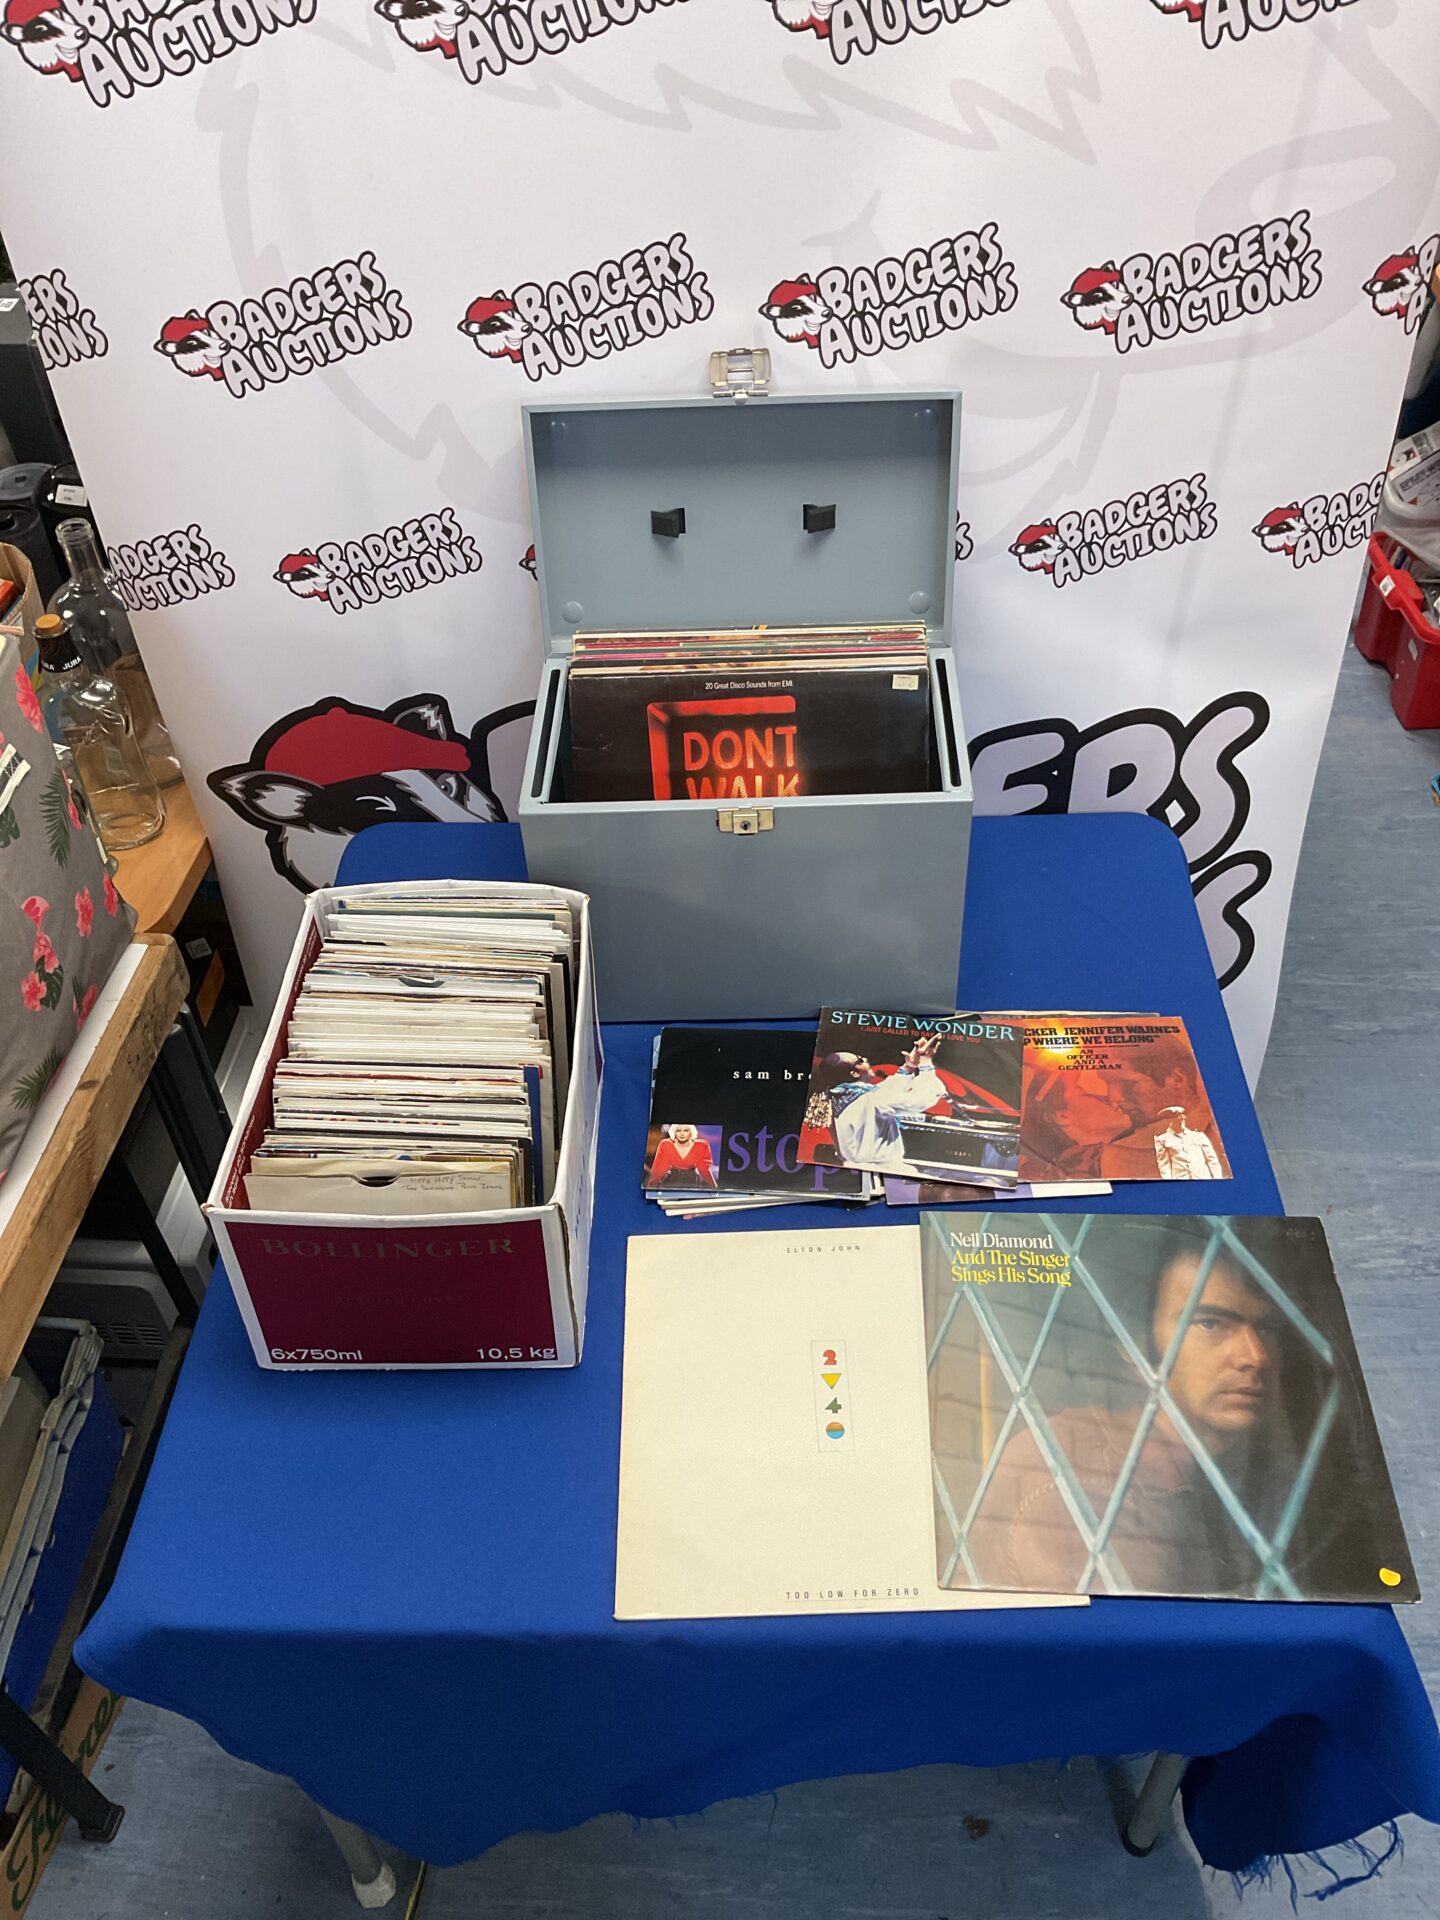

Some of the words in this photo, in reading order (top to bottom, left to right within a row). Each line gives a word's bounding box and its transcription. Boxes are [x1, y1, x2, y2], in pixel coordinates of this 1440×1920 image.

[1120, 208, 1312, 300] BADGERS
[512, 232, 693, 334] BADGERS
[816, 221, 1002, 320] BADGERS
[205, 250, 386, 352] BADGERS
[818, 261, 1018, 369] AUCTIONS
[1114, 249, 1322, 354] AUCTIONS
[521, 271, 714, 382] AUCTIONS
[222, 289, 412, 398] AUCTIONS
[1056, 472, 1207, 550] BADGERS
[316, 507, 462, 578] BADGERS
[1052, 502, 1217, 588] AUCTIONS
[116, 552, 235, 612] UCTIONS
[326, 535, 482, 614] AUCTIONS
[705, 682, 713, 690] 20
[714, 681, 730, 690] Great
[730, 681, 745, 689] Disco
[746, 680, 767, 689] Sounds
[767, 680, 781, 688] from
[684, 726, 798, 771] DONT
[686, 772, 800, 800] WALK
[831, 1011, 907, 1029] STEVIE
[913, 1018, 1015, 1041] WONDER
[883, 1027, 909, 1036] CALLED
[966, 1036, 980, 1044] YOU
[1065, 1026, 1124, 1036] JENNIFER
[1125, 1025, 1180, 1035] WARNES
[1032, 1037, 1080, 1046] WHERE
[1082, 1036, 1102, 1045] WE
[733, 1069, 770, 1080] sam
[1058, 1063, 1122, 1071] GENTLEMAN
[262, 1238, 516, 1260] BOLLINGER
[786, 1246, 822, 1254] ELTON
[950, 1232, 979, 1248] Neil
[982, 1232, 1053, 1249] Diamond
[952, 1250, 984, 1265] And
[987, 1250, 1017, 1266] The
[1019, 1250, 1070, 1270] Singer
[951, 1266, 996, 1285] Sings
[998, 1267, 1025, 1283] His
[1027, 1267, 1072, 1288] Song
[271, 1348, 363, 1361] 6x750ml
[477, 1347, 523, 1361] 10,5
[529, 1347, 555, 1360] kg
[822, 1349, 838, 1366] 2
[825, 1396, 842, 1414] 4
[786, 1591, 809, 1599] TOO
[819, 1590, 844, 1599] LOW
[854, 1589, 877, 1597] FOR
[887, 1587, 919, 1597] ZERO
